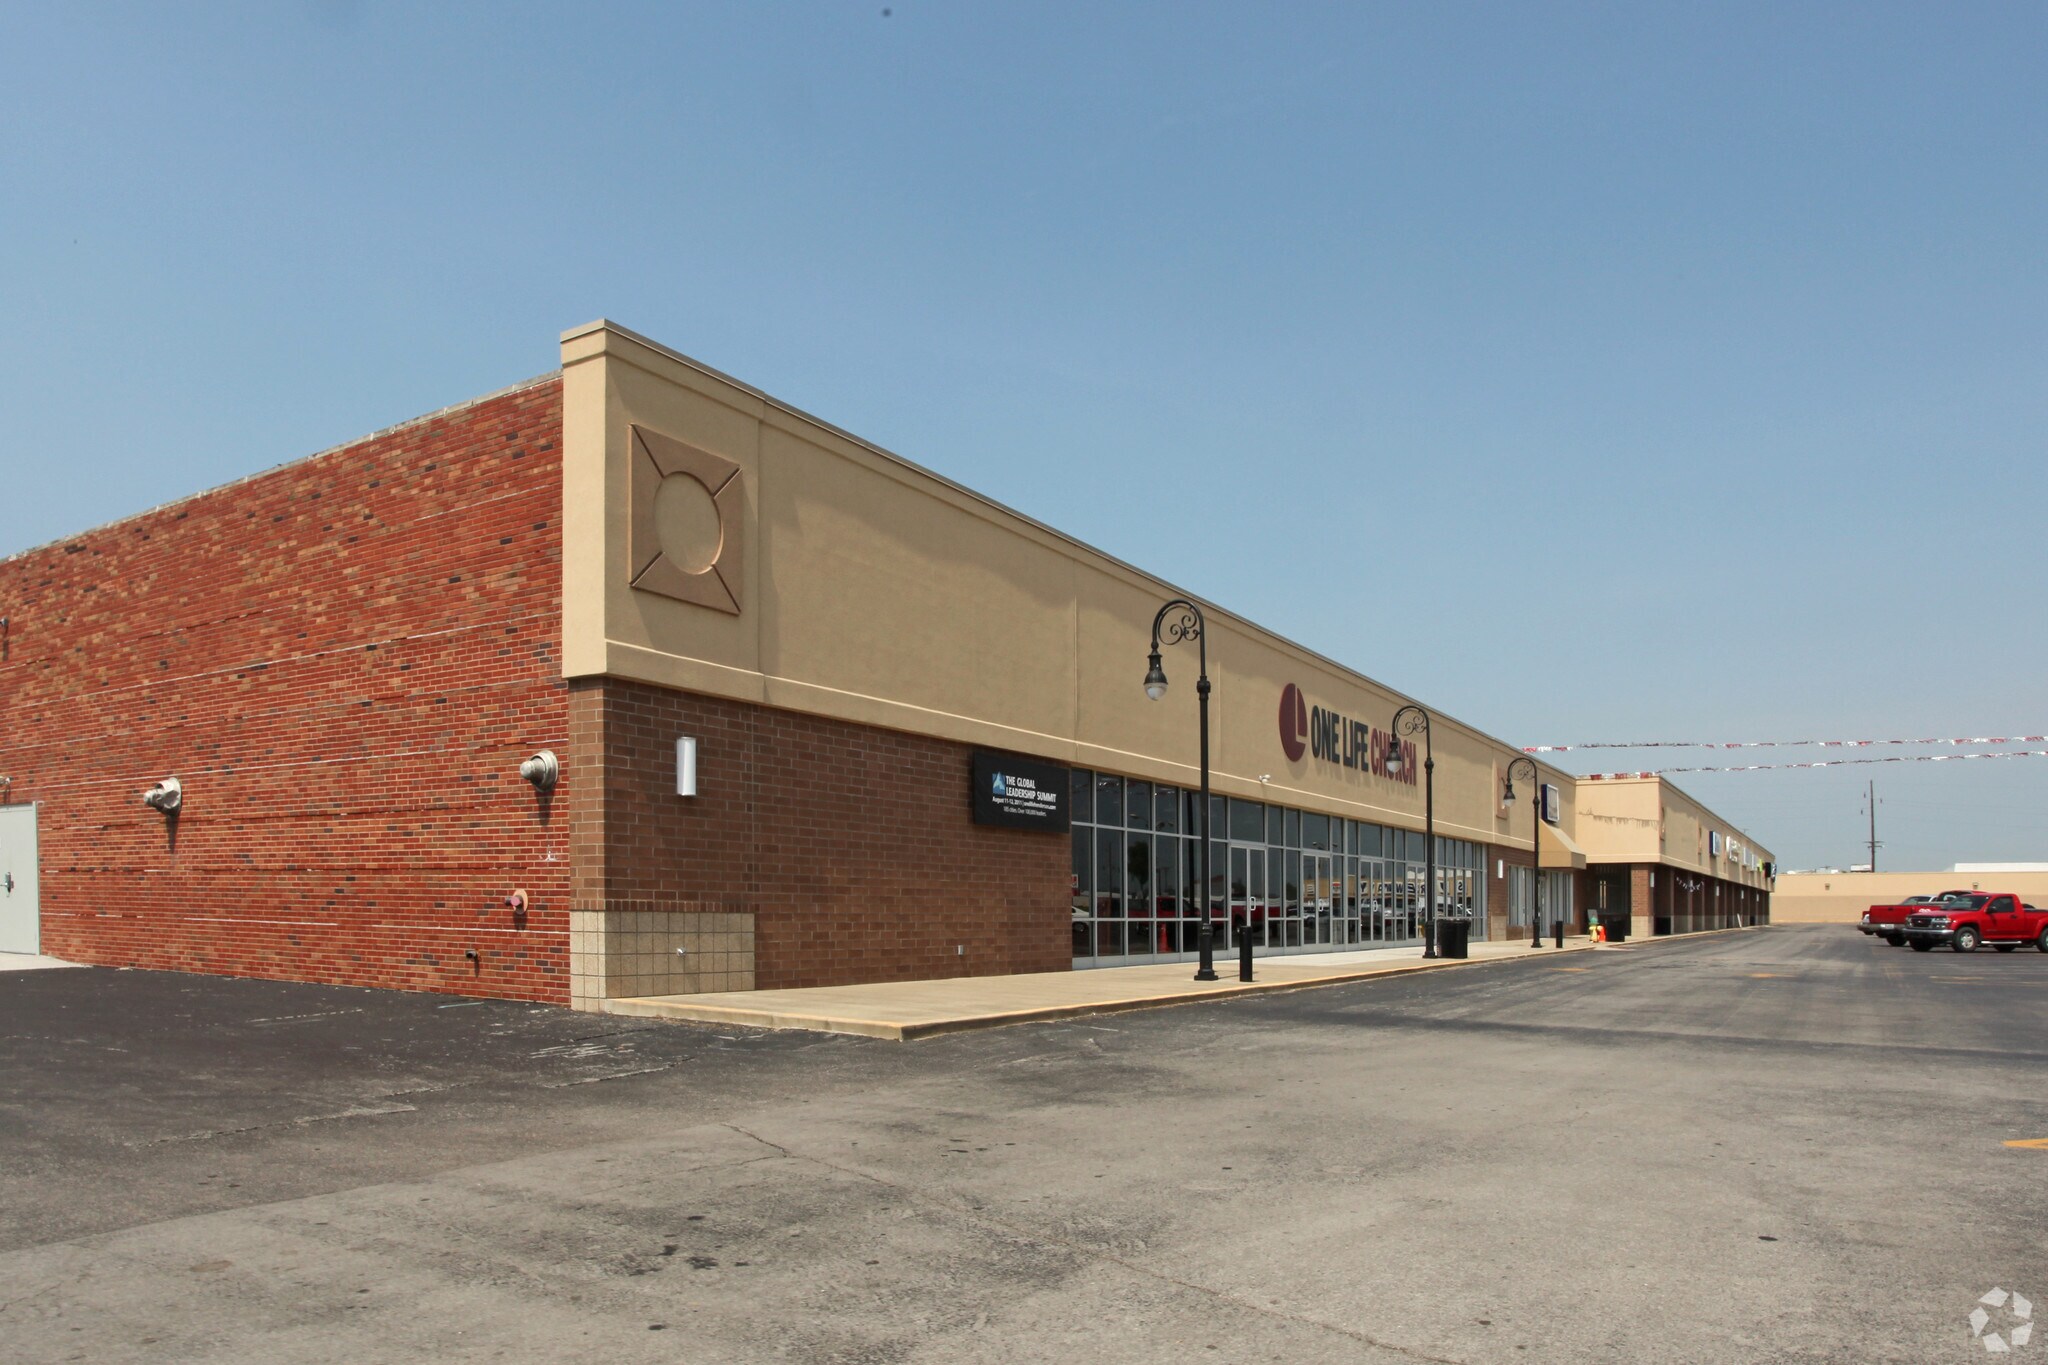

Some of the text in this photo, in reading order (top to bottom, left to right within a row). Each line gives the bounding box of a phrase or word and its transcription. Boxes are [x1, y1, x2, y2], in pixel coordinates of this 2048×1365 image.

[1311, 705, 1340, 764] ONE
[1342, 716, 1368, 772] LIFE
[1006, 775, 1036, 789] THE GLOBAL
[1006, 787, 1057, 803] LEADERSHIP SUMMIT
